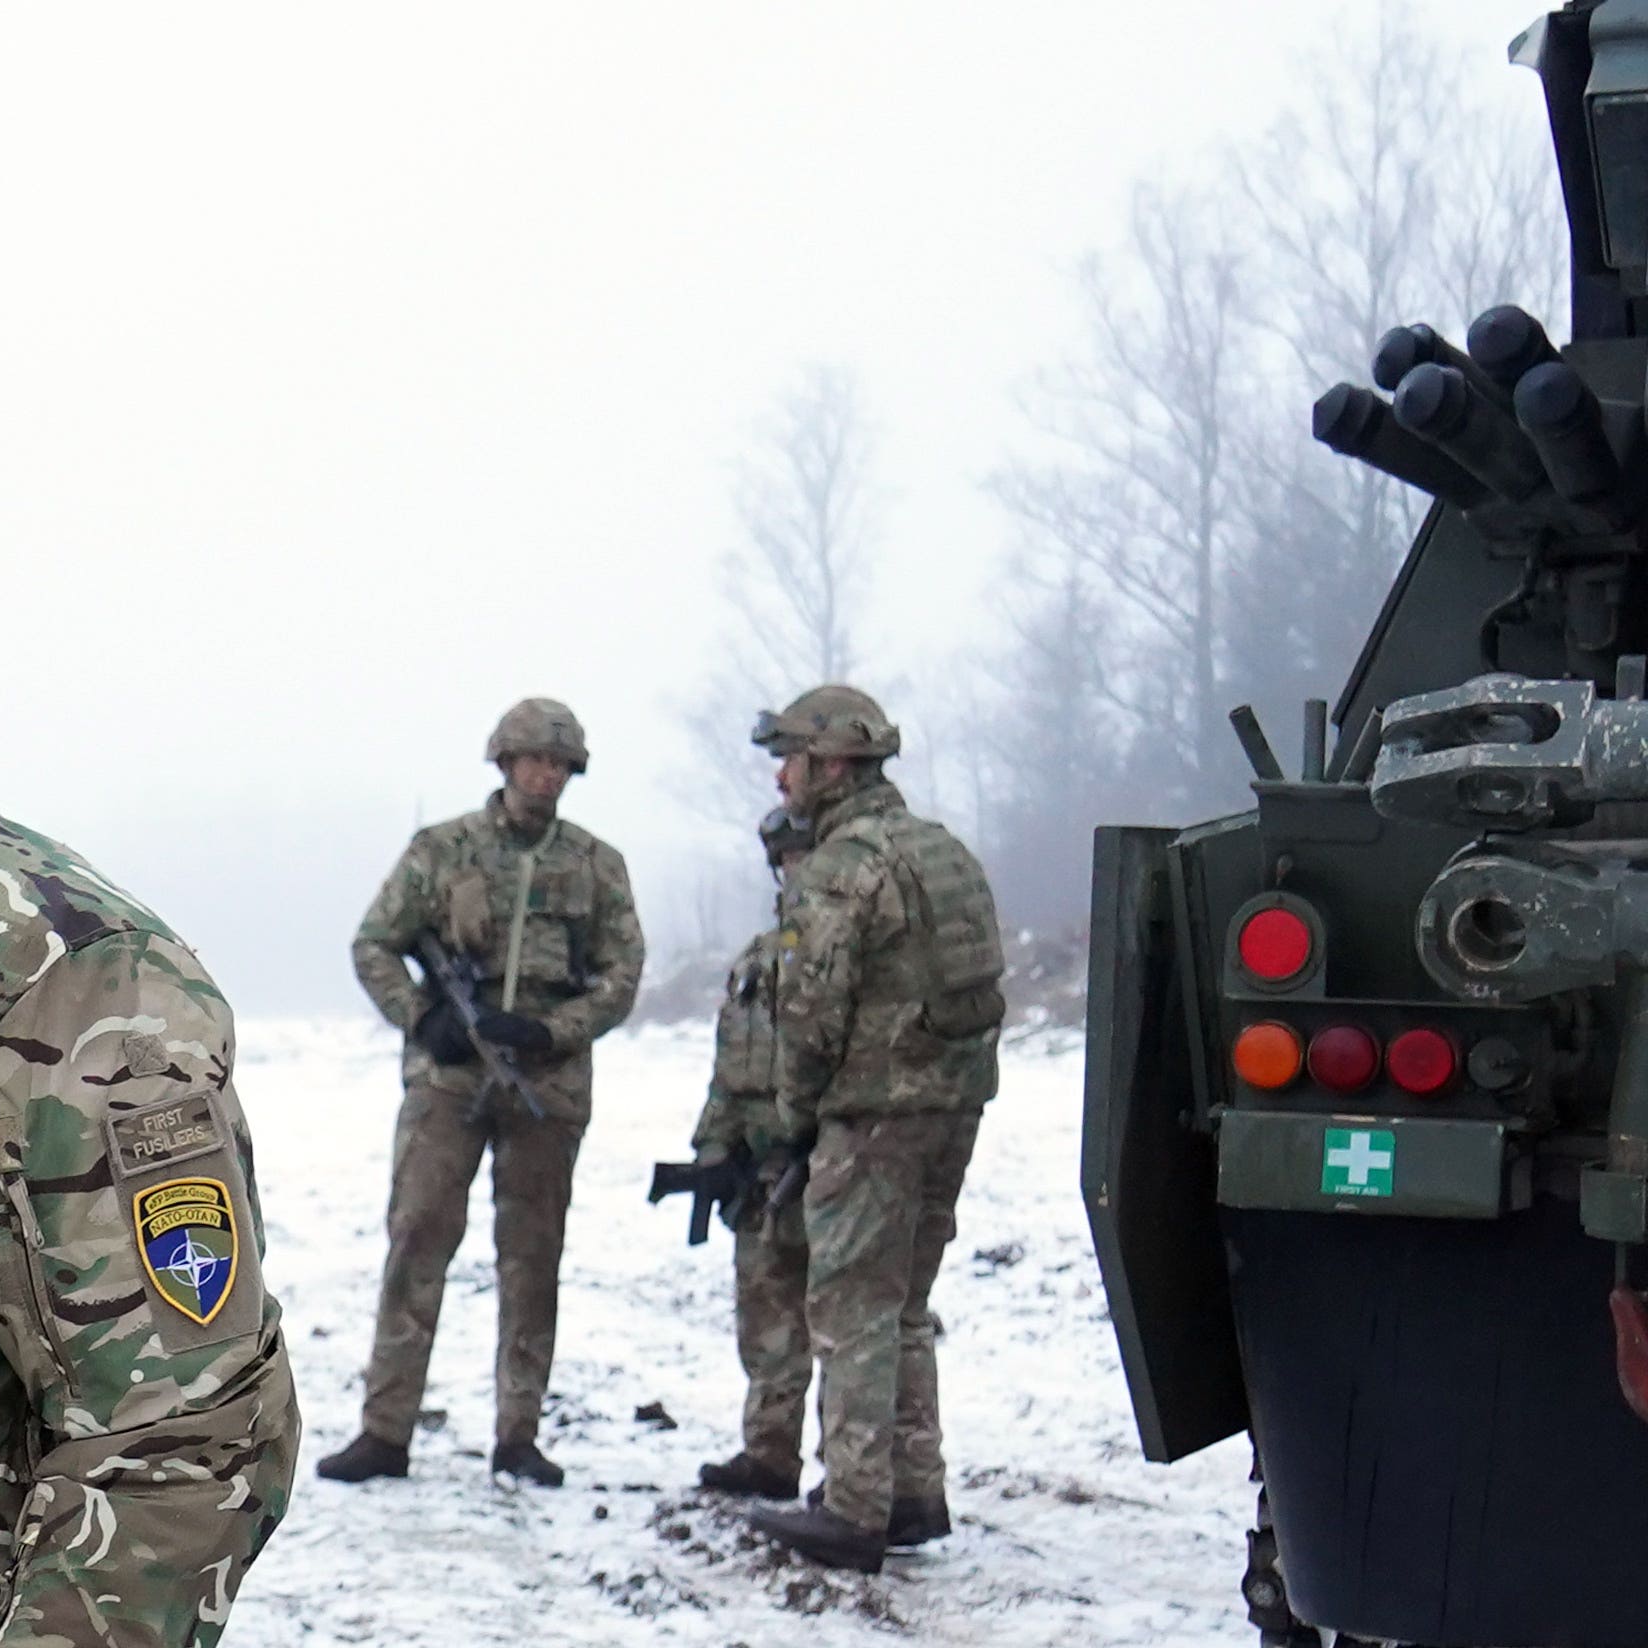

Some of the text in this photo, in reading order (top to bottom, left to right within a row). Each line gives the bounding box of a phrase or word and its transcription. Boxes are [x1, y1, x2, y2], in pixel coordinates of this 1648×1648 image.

[143, 1108, 183, 1132] FIRST
[133, 1125, 206, 1159] FUSILIERS
[188, 1187, 216, 1201] Group
[150, 1209, 219, 1235] NATO-OTAN
